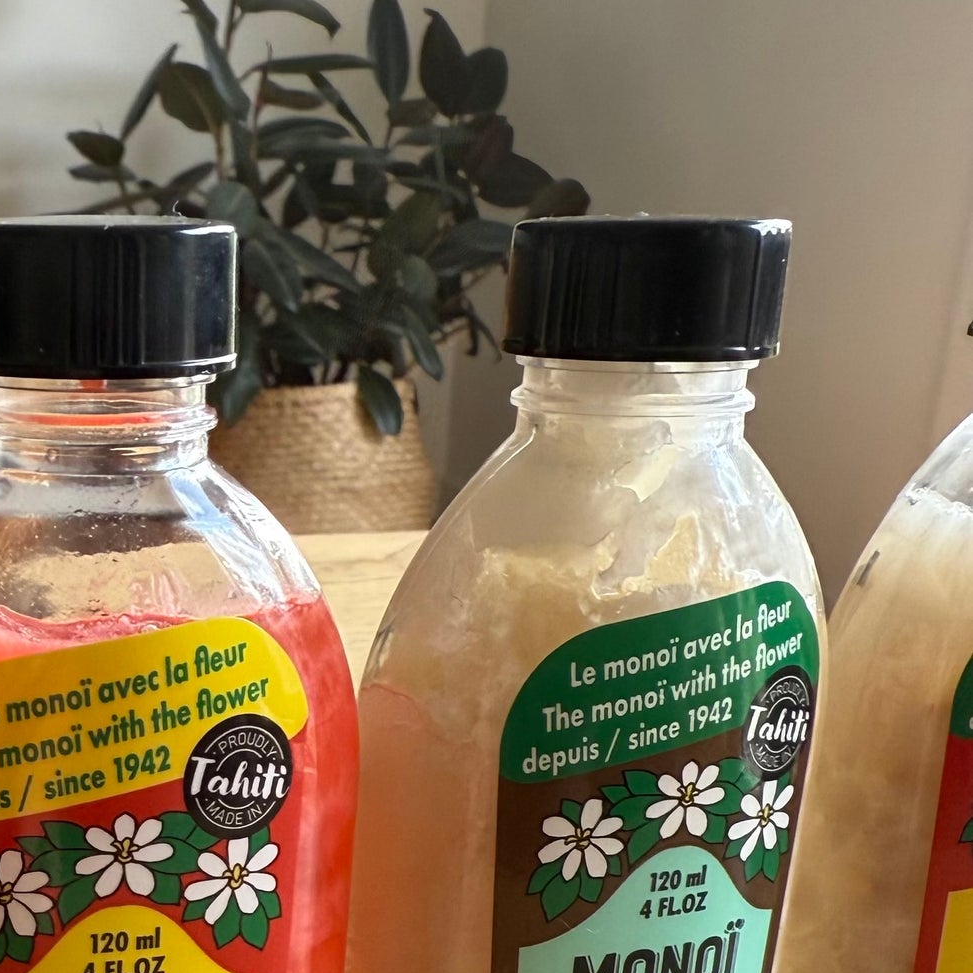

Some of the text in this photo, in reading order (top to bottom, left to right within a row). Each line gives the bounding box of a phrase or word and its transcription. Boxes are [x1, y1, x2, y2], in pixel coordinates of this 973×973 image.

[570, 600, 792, 688] Le monoï avec la fleur
[6, 679, 92, 722] monoï
[99, 671, 160, 703] avec
[165, 656, 189, 688] la
[195, 641, 247, 677] fleur
[543, 632, 803, 732] The monoï with the flower
[88, 714, 145, 749] with
[151, 701, 191, 733] the
[197, 676, 269, 720] flower
[747, 705, 809, 742] Tahiti
[218, 732, 278, 757] PROUDLY
[522, 697, 733, 777] depuis / since 1942
[18, 776, 33, 813] /
[44, 769, 106, 799] since
[113, 745, 171, 782] 1942
[191, 756, 290, 799] Tahiti
[205, 801, 262, 825] MADE IN
[650, 864, 707, 892] 120 ml
[640, 892, 708, 919] 4 FL.OZ
[90, 927, 161, 954] 120 ml
